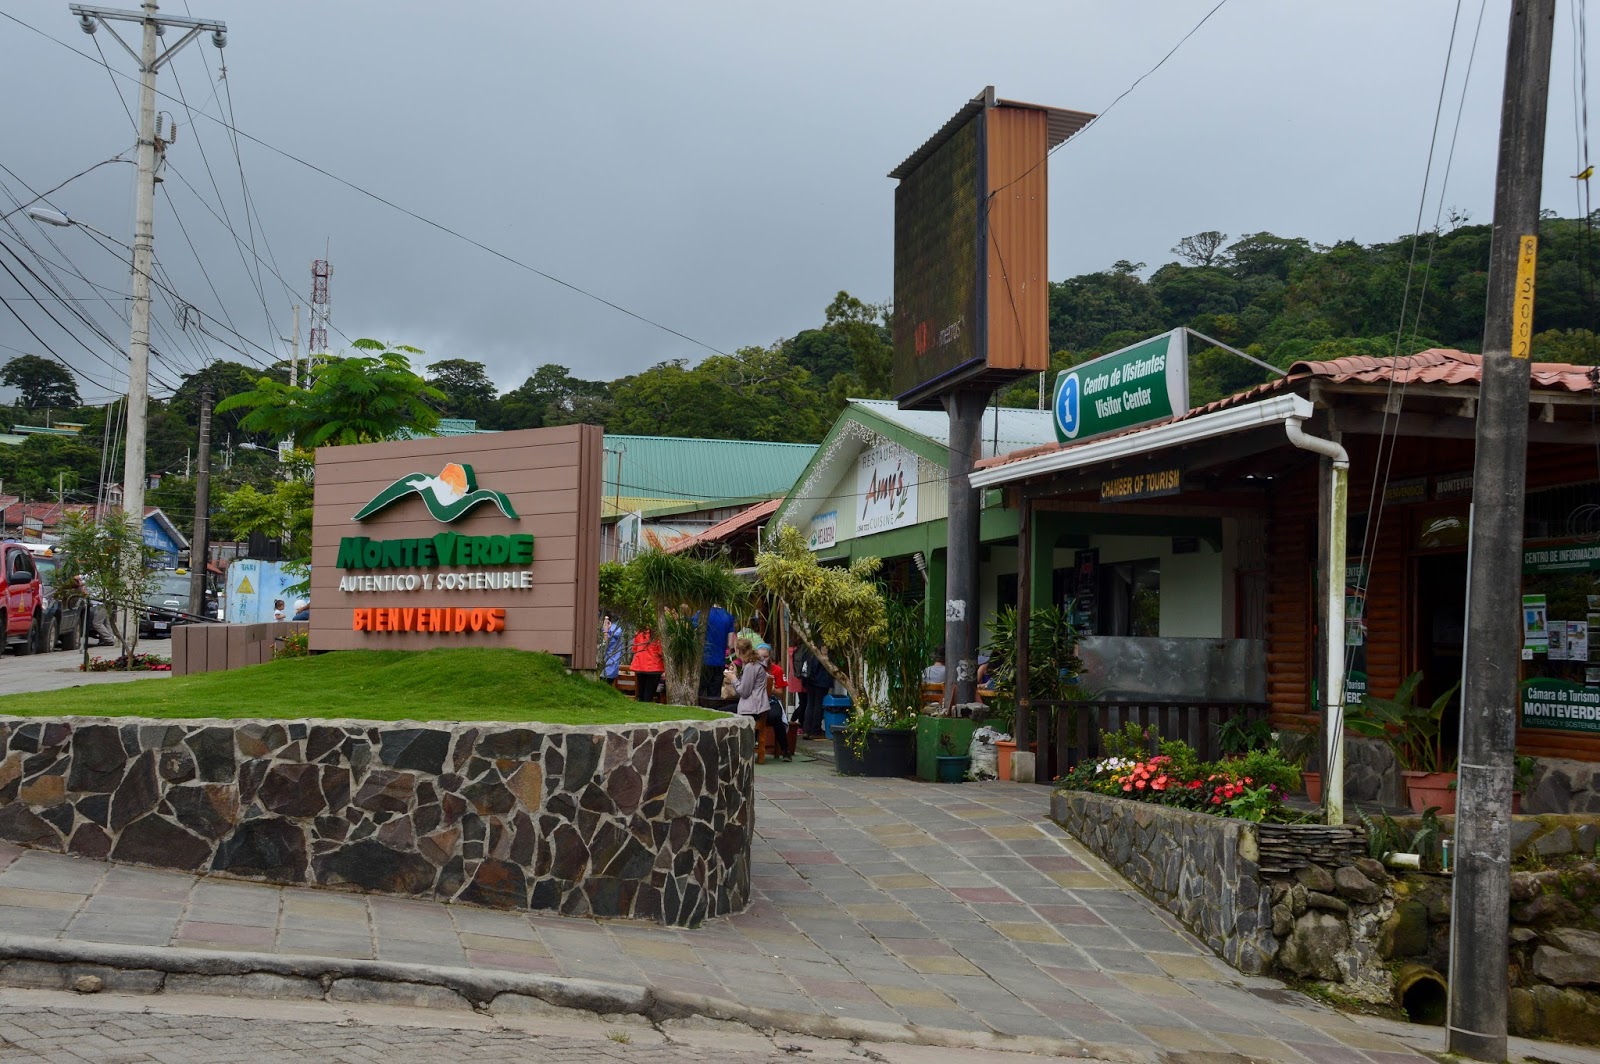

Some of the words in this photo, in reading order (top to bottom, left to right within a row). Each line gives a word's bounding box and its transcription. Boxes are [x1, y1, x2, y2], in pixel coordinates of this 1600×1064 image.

[1083, 373, 1109, 396] Centro
[1110, 367, 1121, 387] de
[1122, 354, 1165, 383] Visitantes
[1095, 396, 1122, 418] Visitor
[1122, 387, 1152, 411] Center
[862, 459, 904, 520] Amy's
[1101, 480, 1133, 499] CHAMBER
[1134, 477, 1144, 494] OF
[1146, 469, 1180, 492] TOURISM
[1436, 476, 1473, 494] MONTEVER
[869, 513, 894, 530] CUISINE
[336, 531, 534, 568] MONTEVERDE
[1524, 551, 1549, 564] CENTRO
[1549, 550, 1559, 562] DE
[241, 563, 256, 571] TAXI
[1344, 565, 1363, 575] ENTER
[339, 574, 420, 592] AUTENTICO
[420, 573, 433, 590] Y
[437, 571, 533, 590] SOSTENIBLE
[353, 607, 506, 633] BIENVENIDOS
[1527, 687, 1556, 701] Cámara
[1557, 688, 1567, 701] de
[1568, 689, 1600, 704] Turismo
[1524, 701, 1600, 721] MONTEVERDE
[1525, 717, 1558, 727] AUTENTICO
